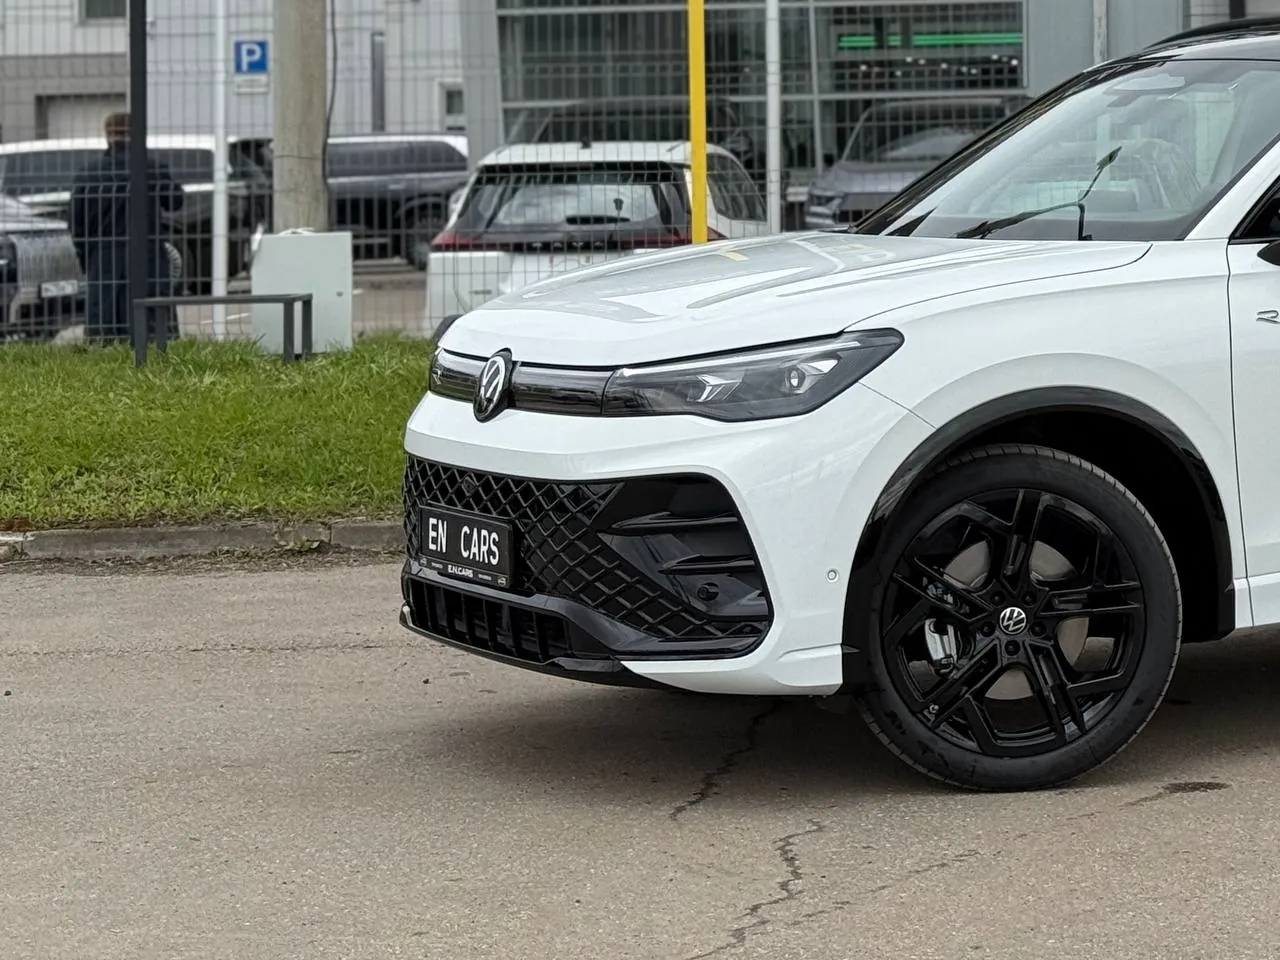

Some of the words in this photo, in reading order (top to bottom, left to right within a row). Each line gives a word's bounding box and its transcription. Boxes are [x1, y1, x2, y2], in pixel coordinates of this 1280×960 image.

[241, 43, 262, 72] P
[428, 517, 447, 553] EN
[460, 525, 499, 565] CARS
